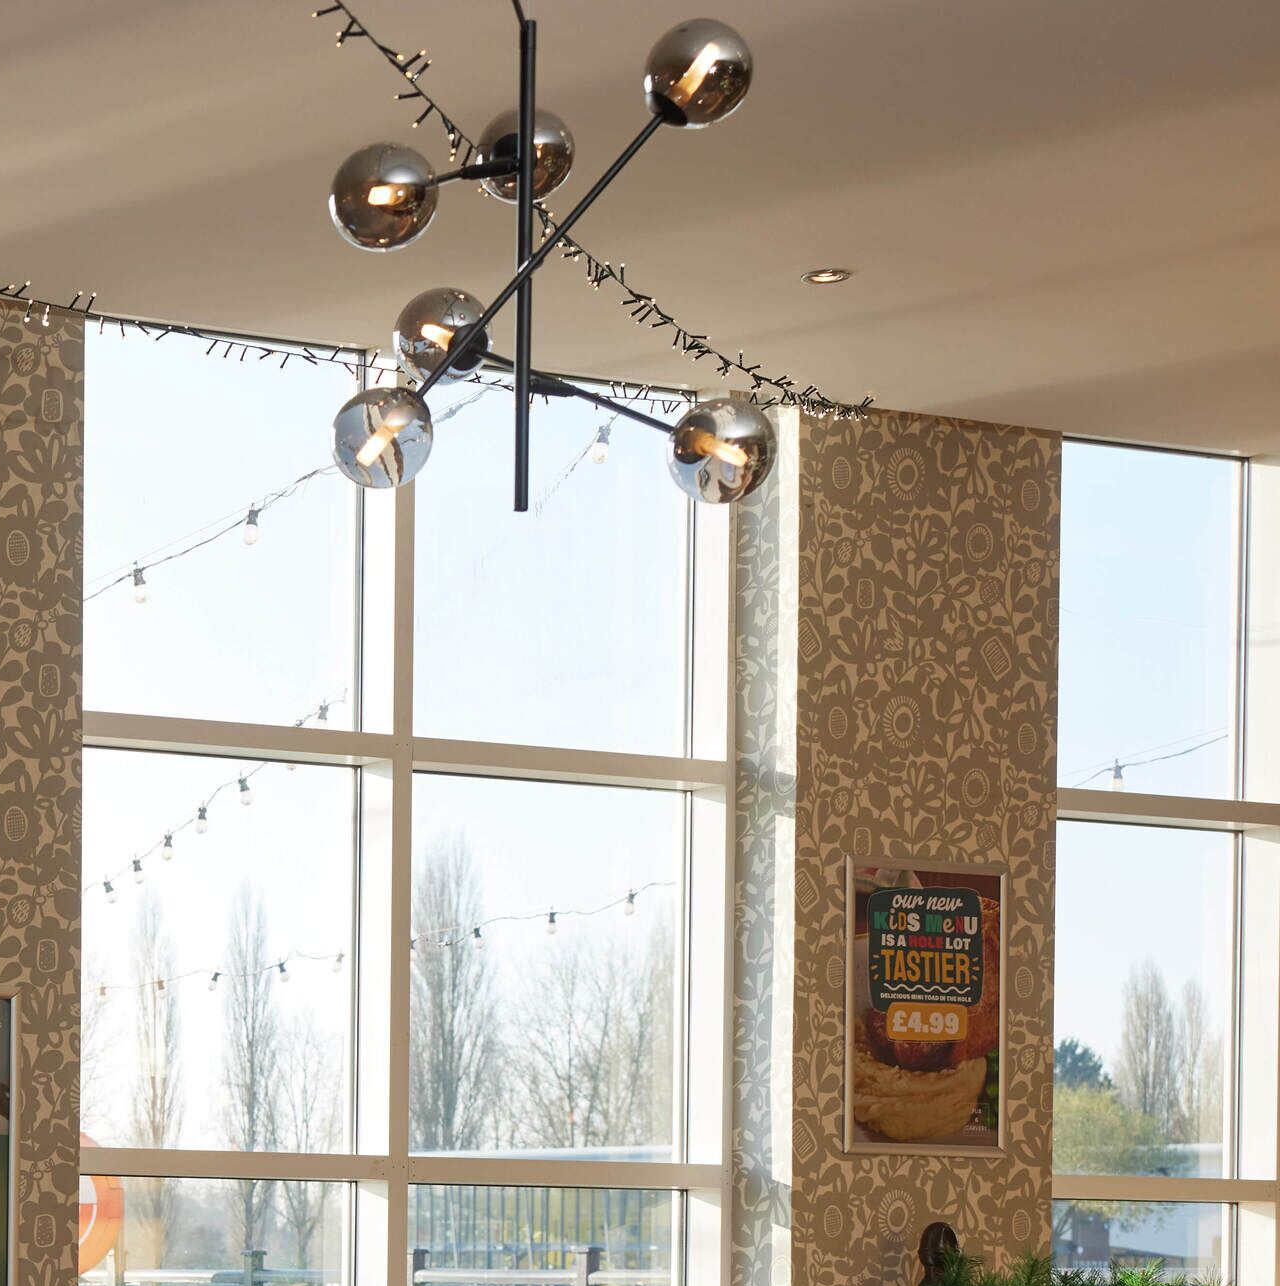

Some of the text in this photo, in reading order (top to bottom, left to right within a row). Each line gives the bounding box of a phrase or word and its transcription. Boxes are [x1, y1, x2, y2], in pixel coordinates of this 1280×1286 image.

[892, 894, 964, 911] our new
[881, 933, 971, 950] IS A HOLE LOT
[880, 949, 971, 985] TASTIER
[880, 992, 910, 1000] DELICIOUS
[891, 1010, 960, 1035] £4.99
